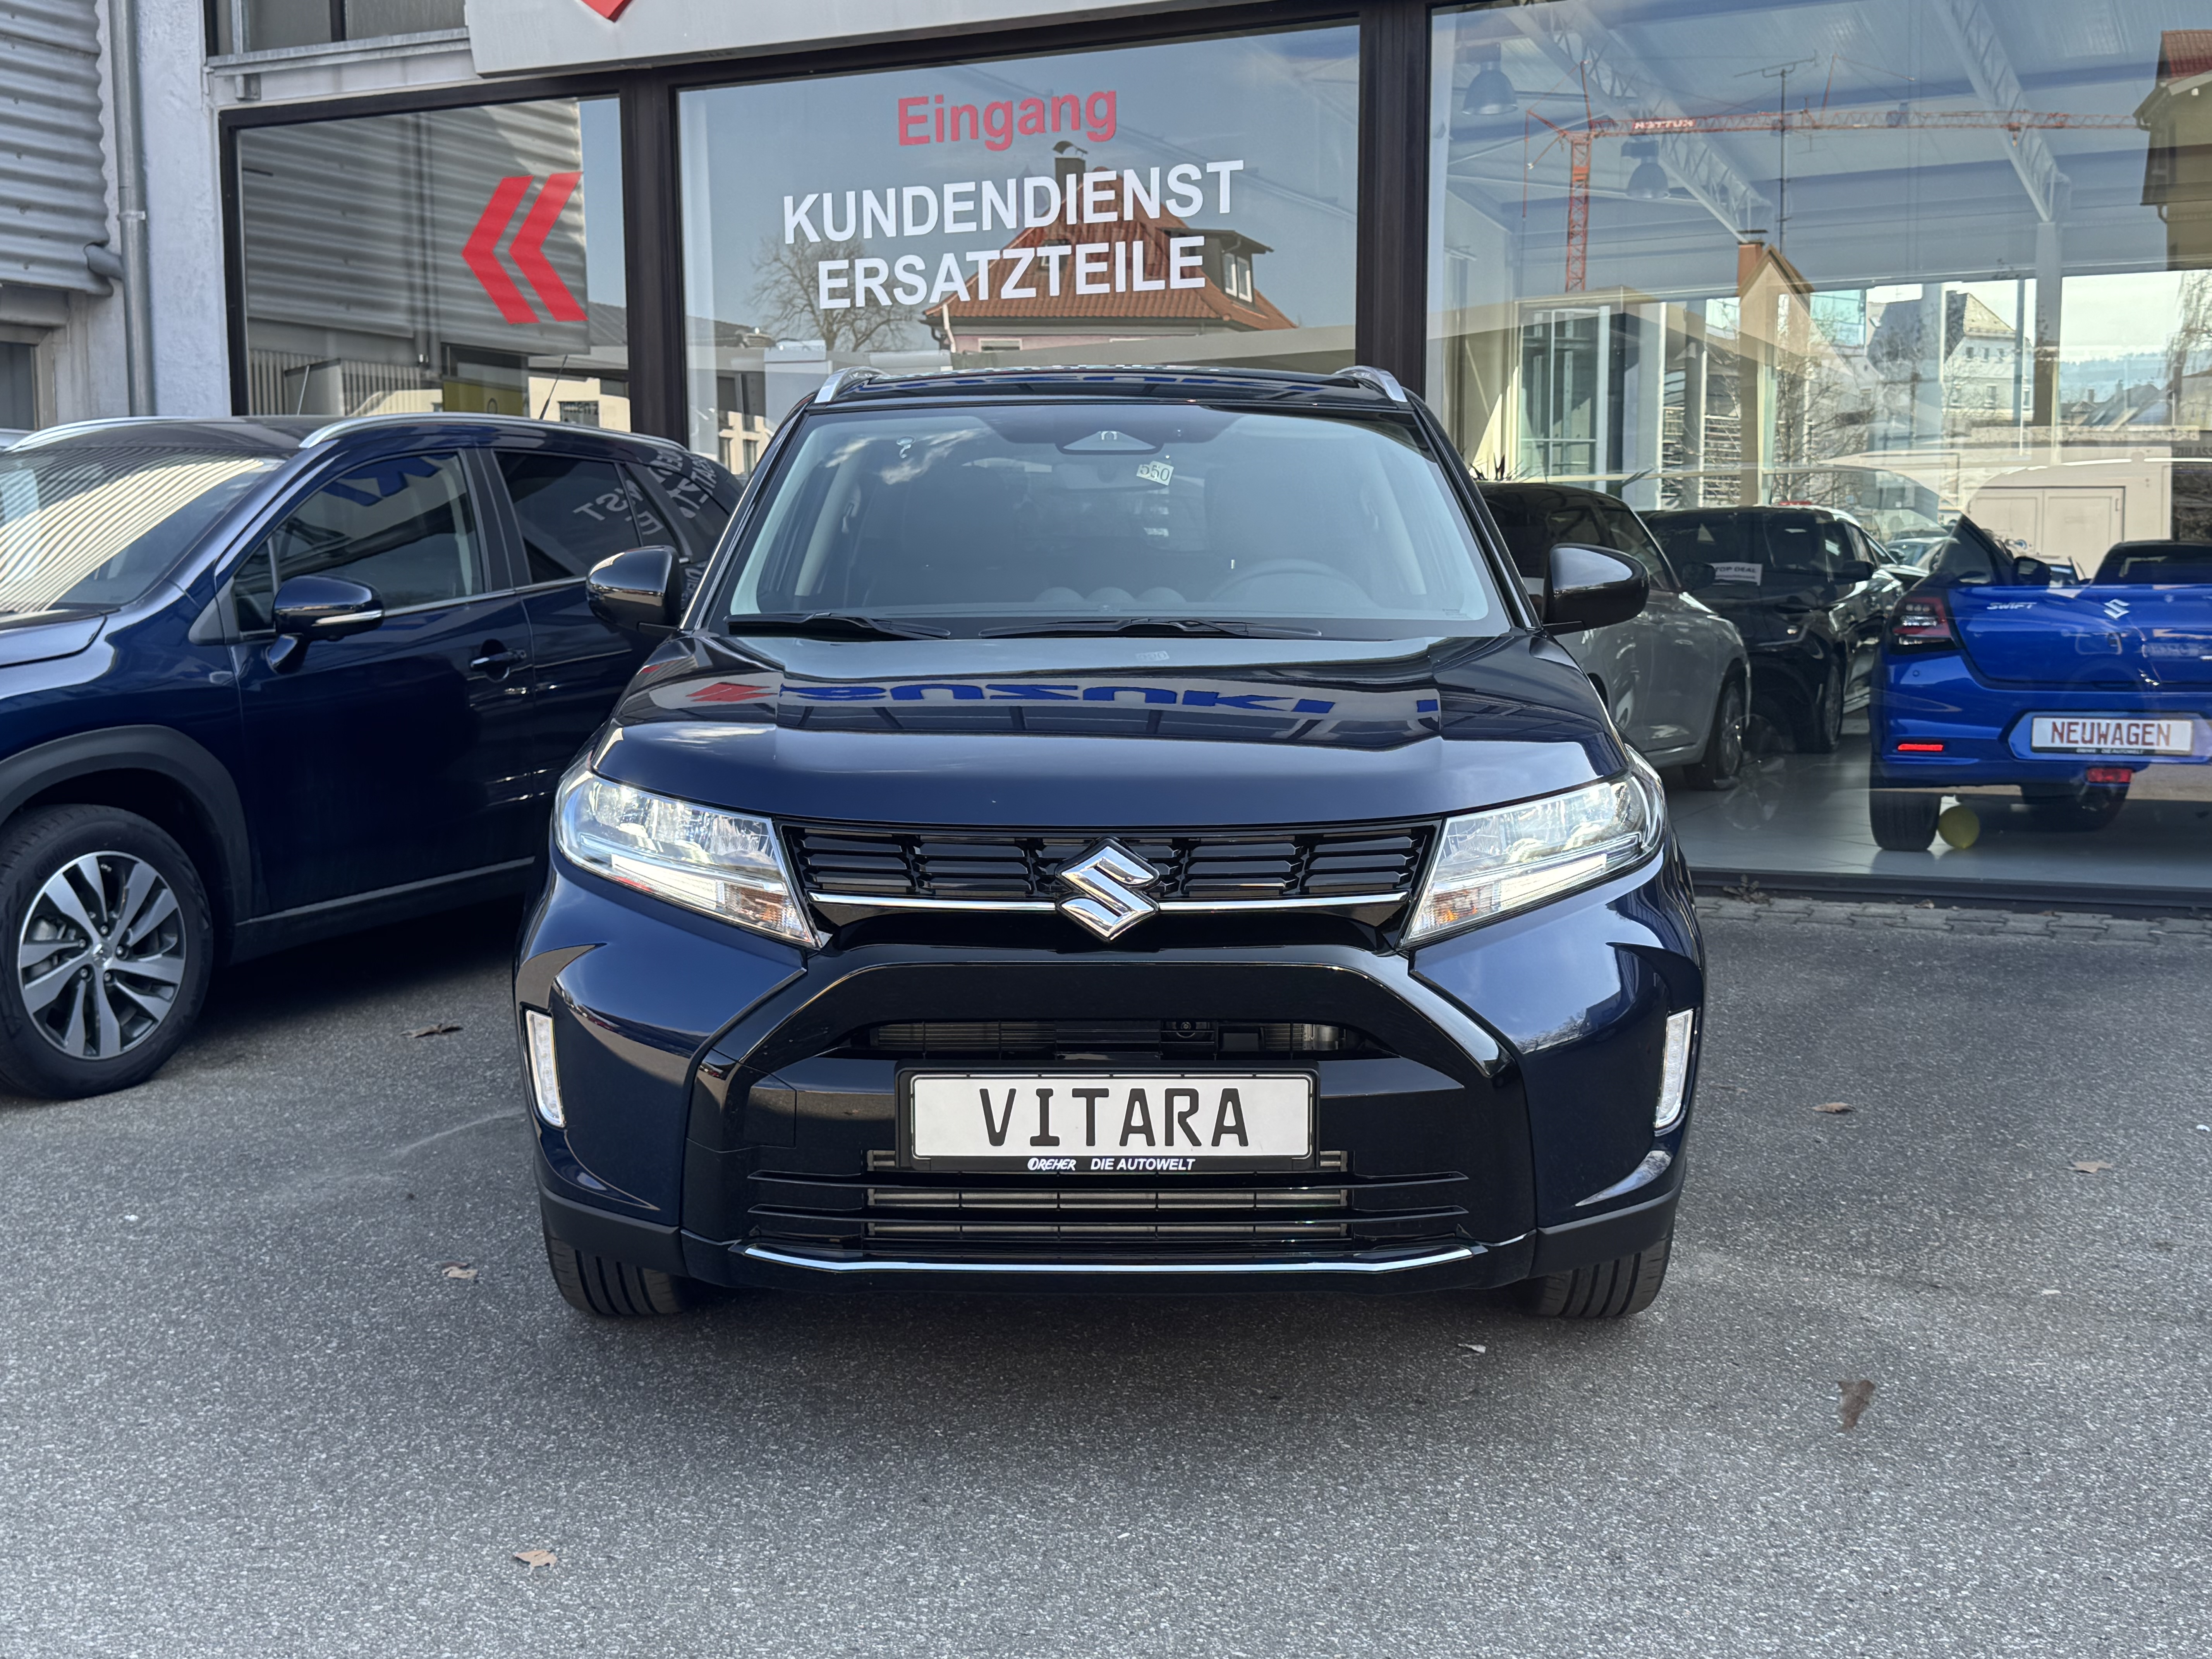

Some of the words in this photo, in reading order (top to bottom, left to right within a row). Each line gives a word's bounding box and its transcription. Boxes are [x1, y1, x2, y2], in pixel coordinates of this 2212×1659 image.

[898, 89, 1116, 151] Eingang
[783, 160, 1244, 244] KUNDENDIENST
[818, 235, 1205, 309] ERSATZTEILE
[2051, 721, 2171, 746] NEUWAGEN
[979, 1088, 1249, 1147] VITARA
[1091, 1158, 1115, 1170] DIE
[1117, 1158, 1196, 1170] AUTOWELT
